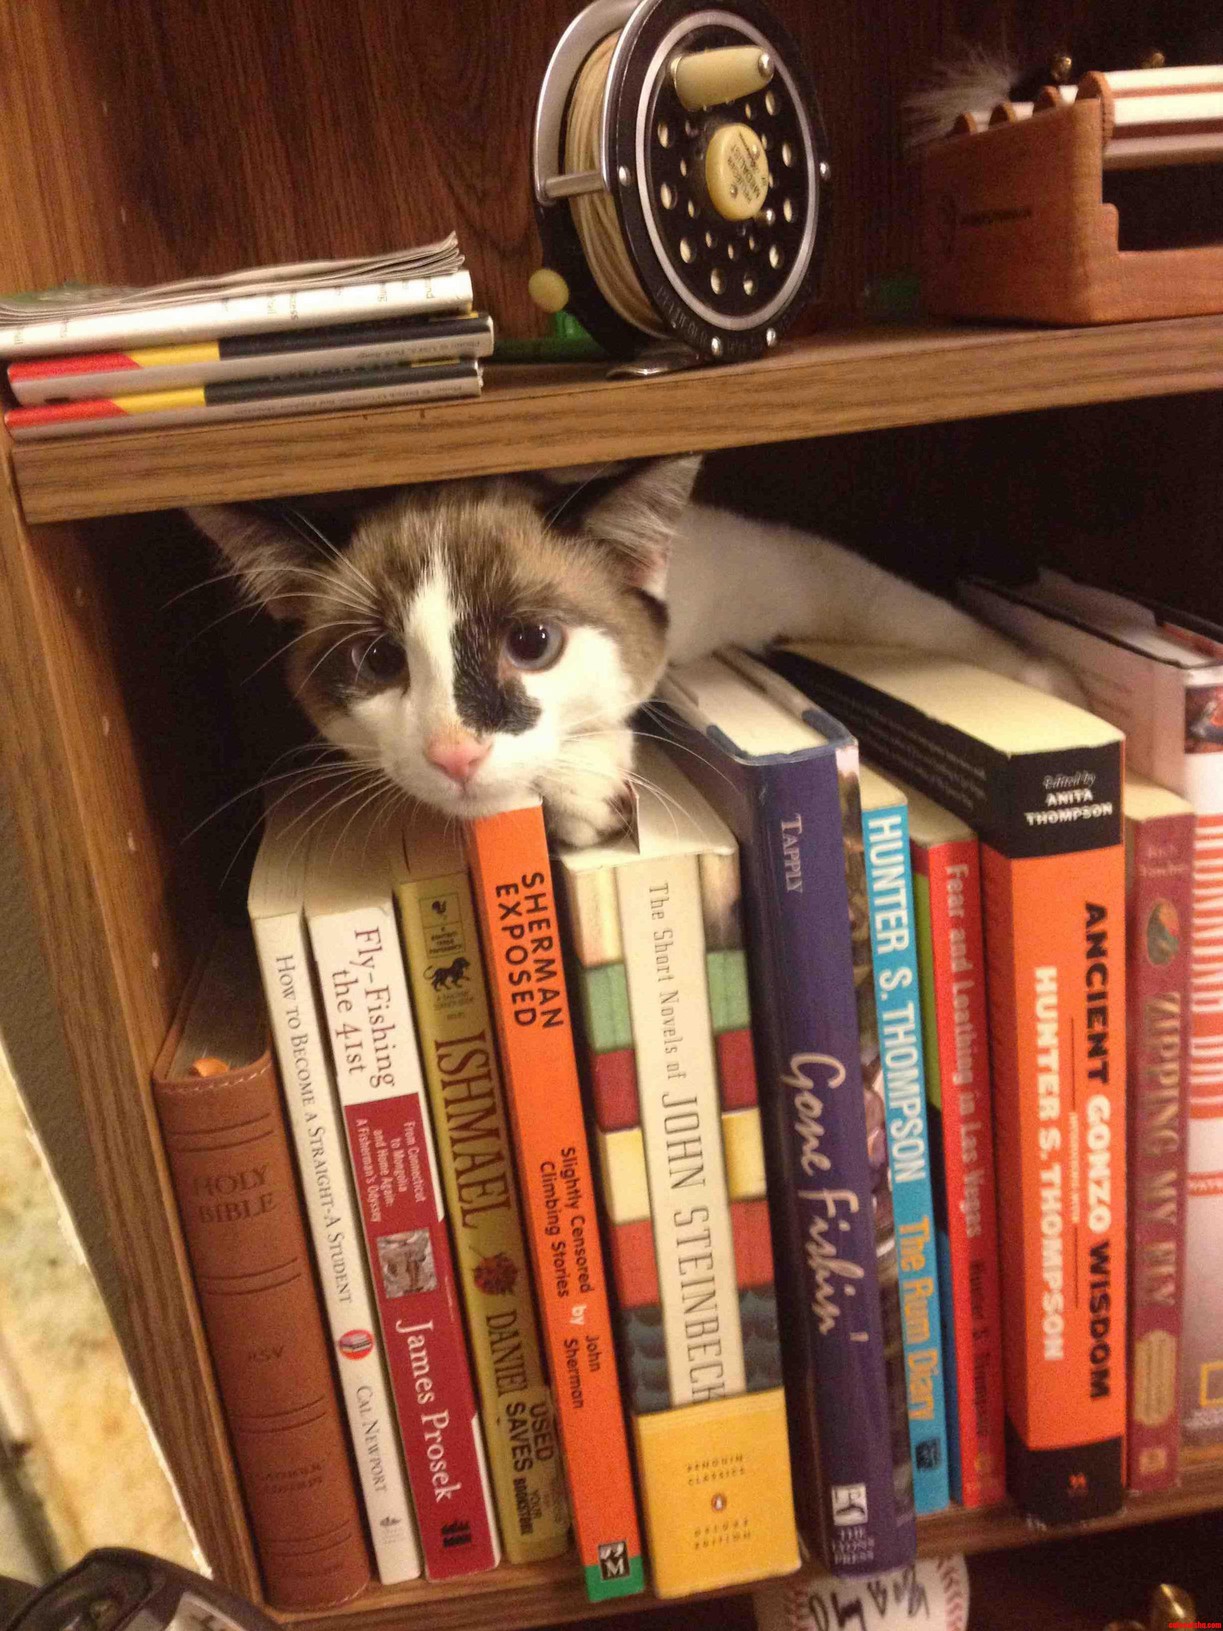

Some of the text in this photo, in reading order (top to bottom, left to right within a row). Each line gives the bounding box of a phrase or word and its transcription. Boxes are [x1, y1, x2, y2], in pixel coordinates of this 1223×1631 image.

[1046, 788, 1094, 807] ANITA
[1083, 769, 1096, 788] by
[1024, 802, 1113, 826] THOMPSON
[781, 812, 804, 893] TAPPLY
[496, 882, 537, 1027] EXPOSED
[521, 872, 565, 1029] SHERMAN
[649, 882, 687, 1080] The Short Novels of
[332, 969, 368, 1076] the 41st
[350, 926, 396, 1089] Fly-Fishing
[868, 815, 926, 1183] HUNTER S. THOMPSON
[945, 863, 985, 1238] Fear and Loathing in Las Vegas
[1143, 991, 1181, 1158] ZIPPING
[356, 1119, 369, 1127] A
[358, 1127, 378, 1184] Fisherman's
[373, 1130, 388, 1148] and
[434, 1029, 511, 1229] ISHMAEL
[1085, 901, 1111, 1400] ANCIENT GONZO WISDOM
[193, 1164, 270, 1196] HOLY
[377, 1149, 390, 1176] Home
[390, 1138, 409, 1193] to Mongolia
[403, 1121, 427, 1203] From Connecticut
[1035, 965, 1065, 1361] HUNTER S. THOMPSON
[1142, 1168, 1177, 1226] MY
[199, 1193, 278, 1223] BIBLE
[540, 1161, 571, 1299] Climbing Stories
[560, 1147, 595, 1294] Slightly Censored
[780, 1053, 870, 1343] Gone Fishin'
[661, 1093, 727, 1401] JOHN STEINBECK
[899, 1216, 931, 1272] The
[1140, 1240, 1177, 1308] FLY
[569, 1304, 588, 1326] by
[902, 1276, 935, 1345] Rum
[563, 1338, 584, 1409] Sherman
[585, 1335, 603, 1372] John
[395, 1318, 463, 1504] James Prosek
[506, 1402, 533, 1472] SAVES
[530, 1403, 554, 1462] USED
[686, 1454, 744, 1473] PENGUIN
[687, 1467, 746, 1486] CLASSICS
